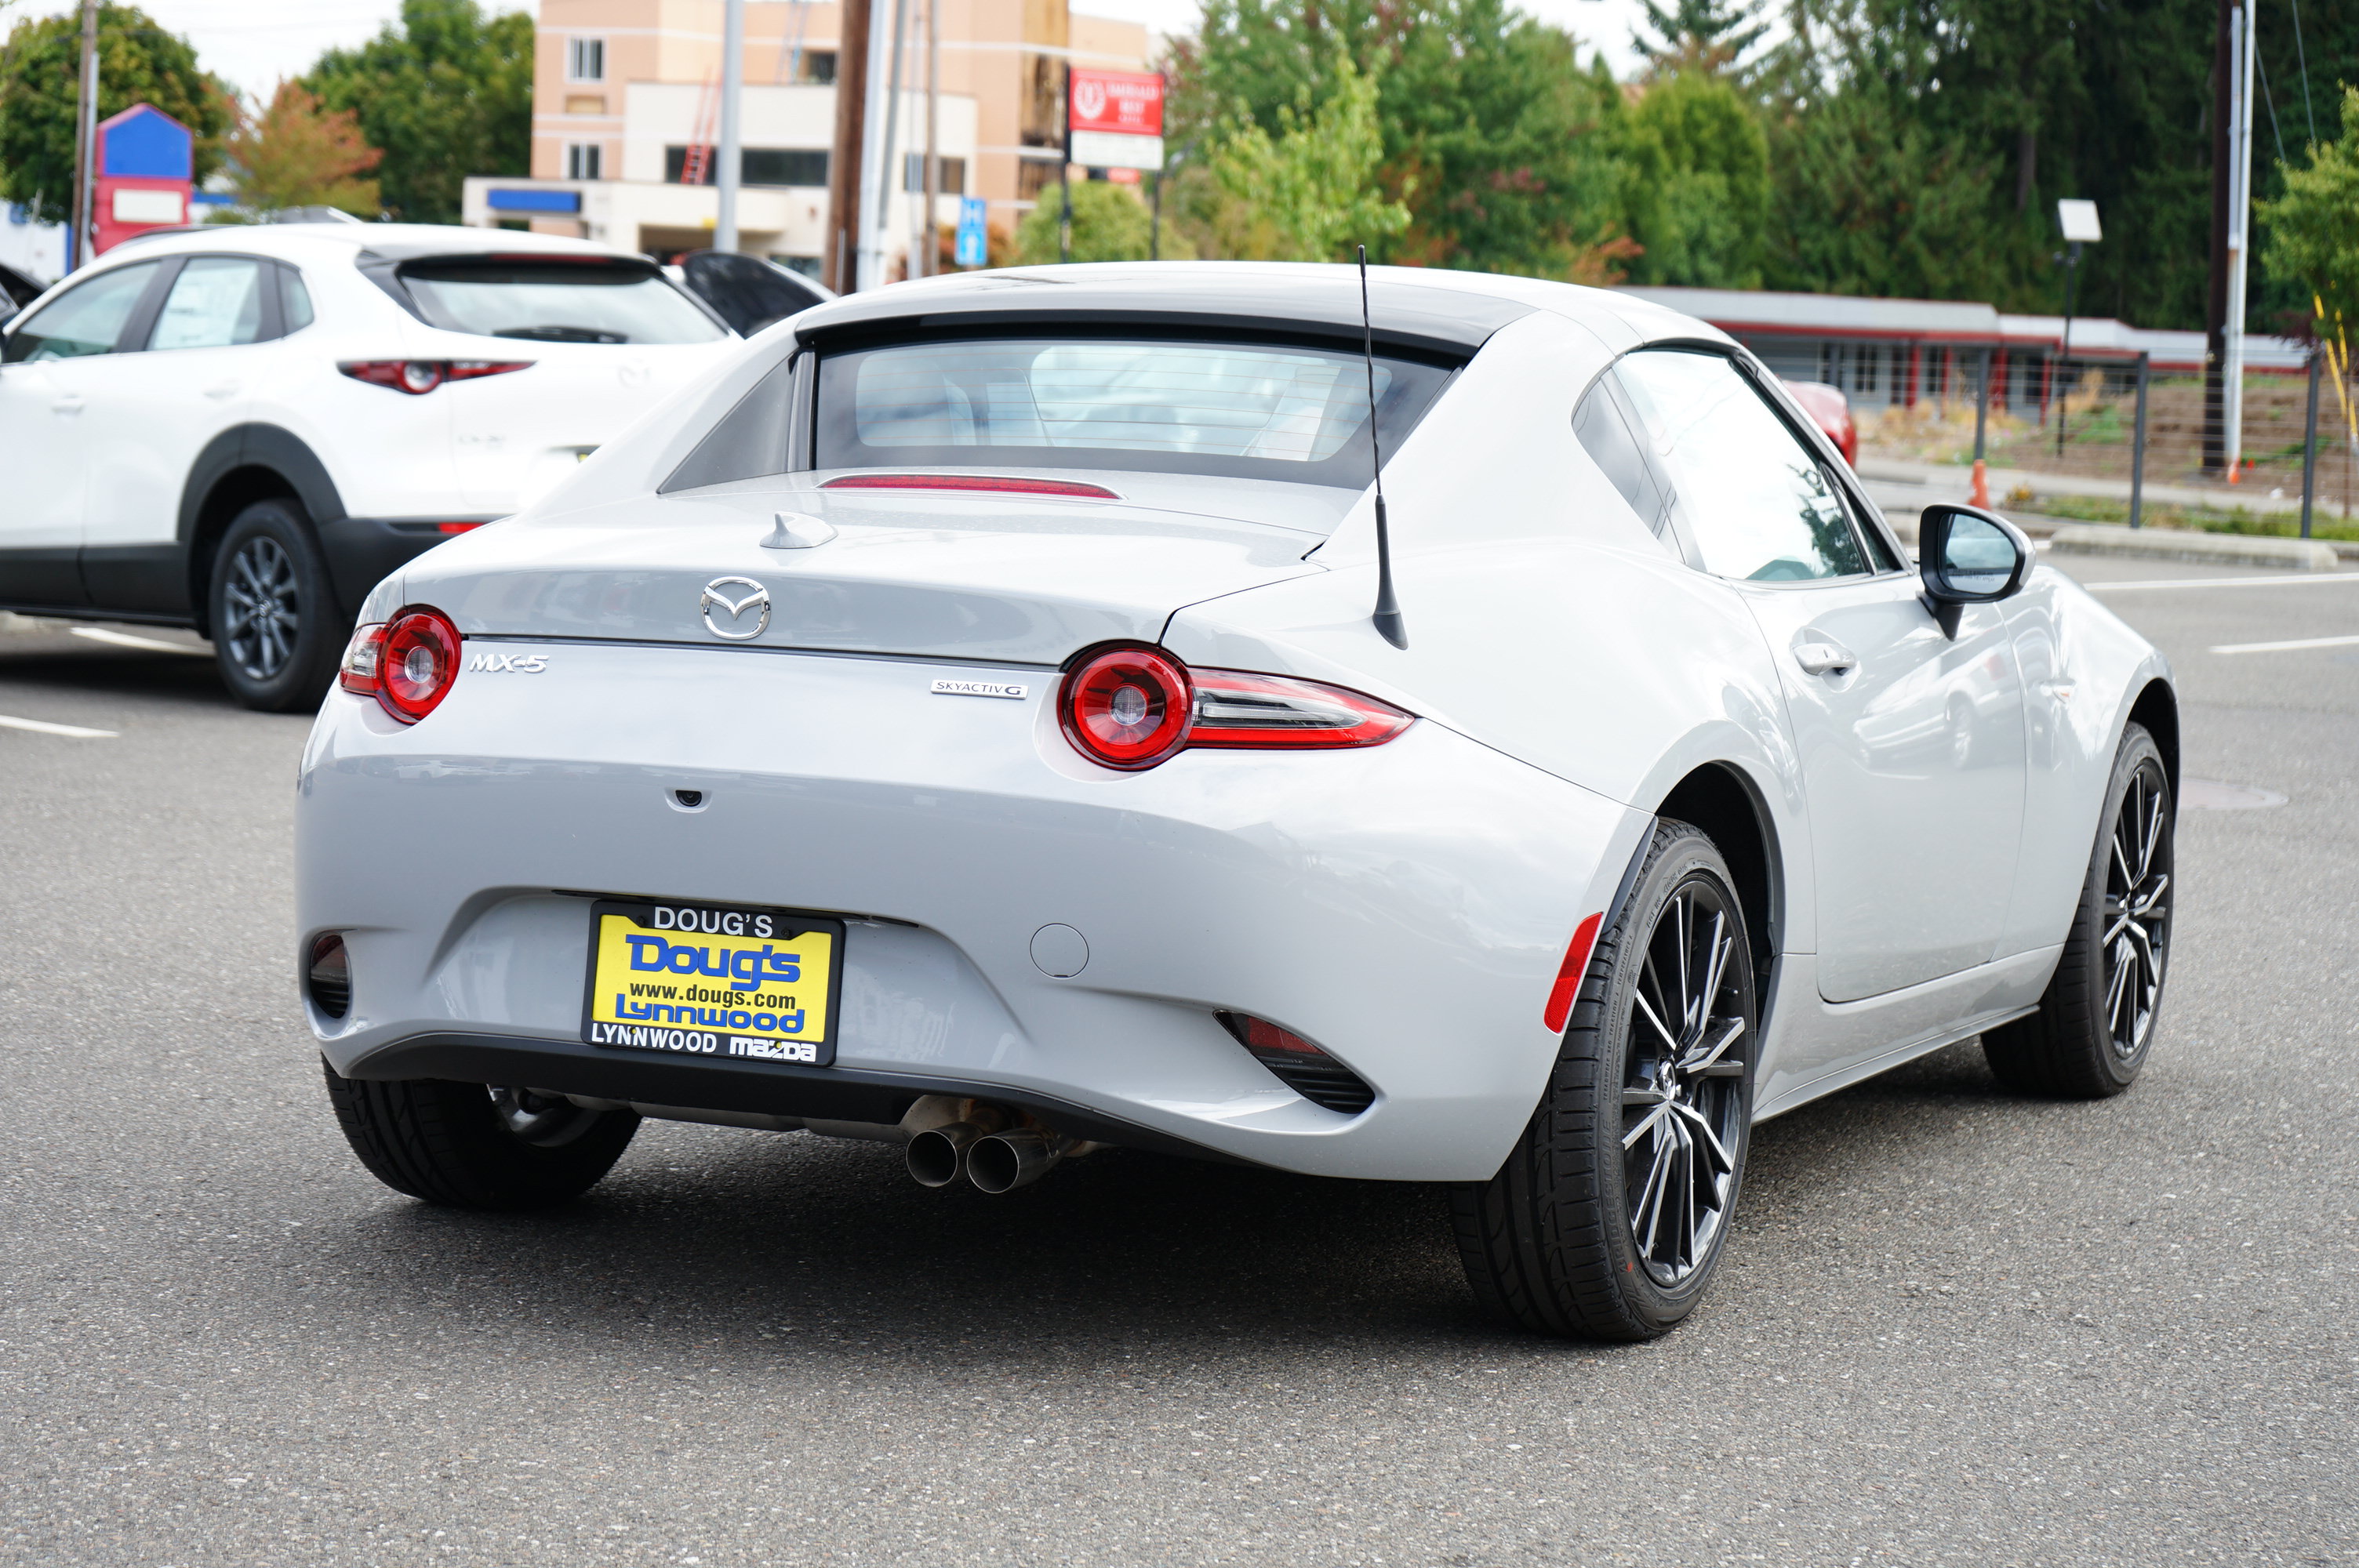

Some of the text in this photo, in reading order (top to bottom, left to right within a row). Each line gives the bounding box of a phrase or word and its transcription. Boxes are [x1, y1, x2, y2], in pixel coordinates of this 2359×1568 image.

[469, 653, 550, 673] MX-5
[654, 906, 773, 938] DOUG'S
[625, 934, 801, 992] Doug's
[630, 983, 796, 1009] www.dougs.com
[616, 993, 805, 1033] Lynnwood
[591, 1022, 717, 1053] LYNNWOOD
